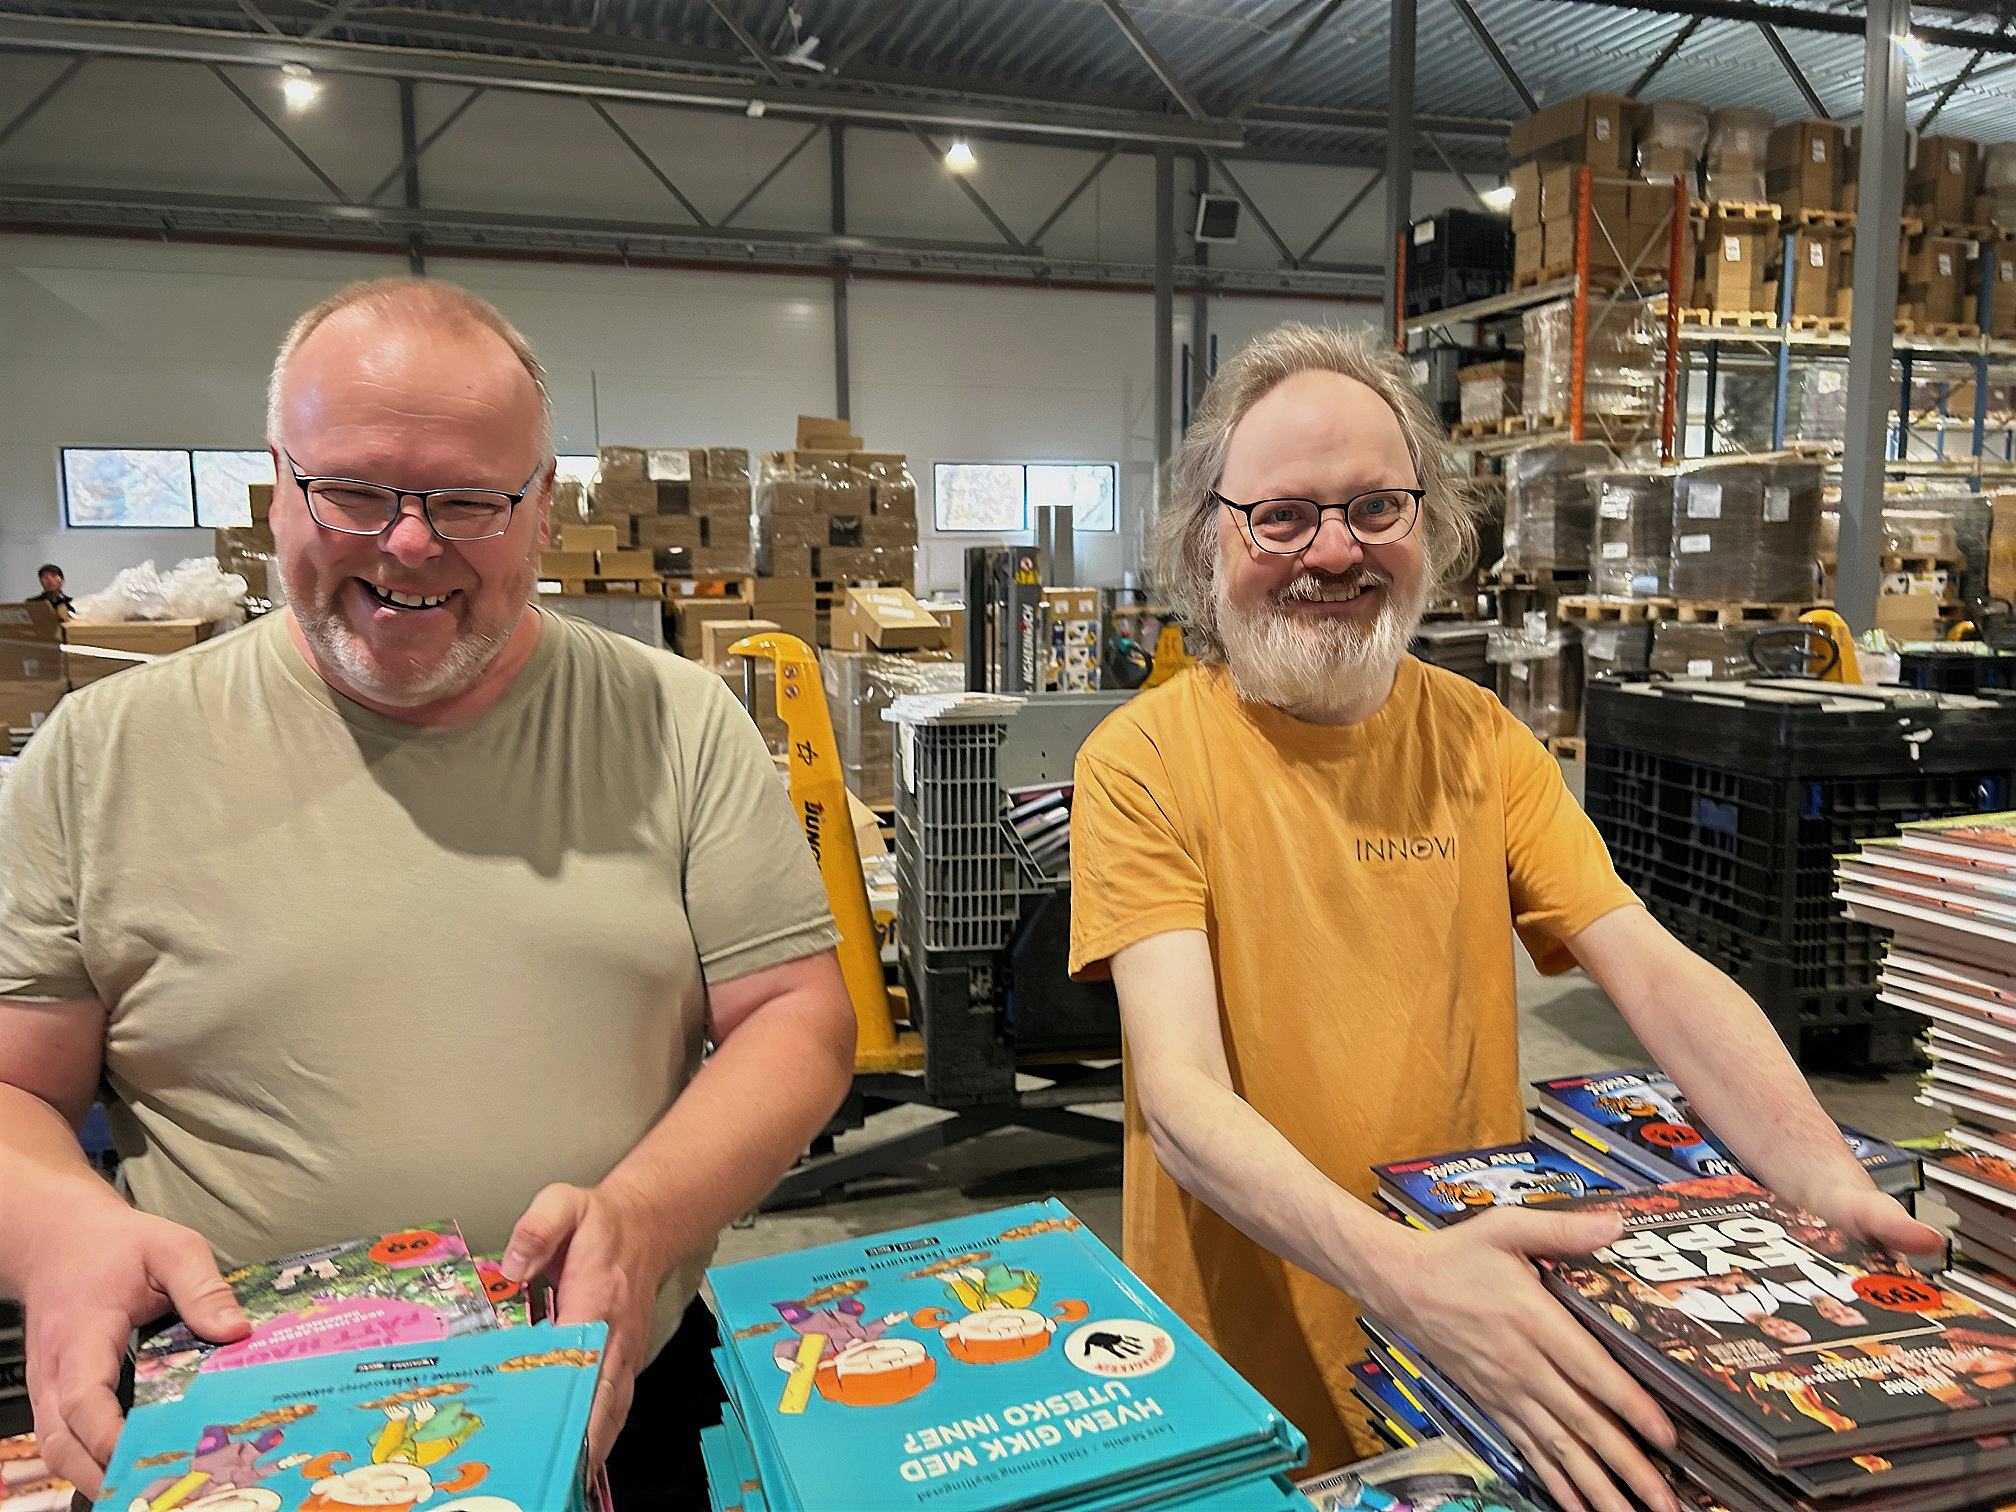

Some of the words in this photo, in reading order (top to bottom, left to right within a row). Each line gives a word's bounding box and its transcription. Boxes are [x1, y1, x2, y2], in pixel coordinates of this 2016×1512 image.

[1630, 1238, 1814, 1282] FYR
[1003, 1381, 1131, 1426] UTESKO
[1064, 1397, 1163, 1438] HVEM
[904, 1413, 1000, 1454] INNE?
[979, 1424, 1062, 1461] GIKK
[899, 1446, 978, 1482] MED
